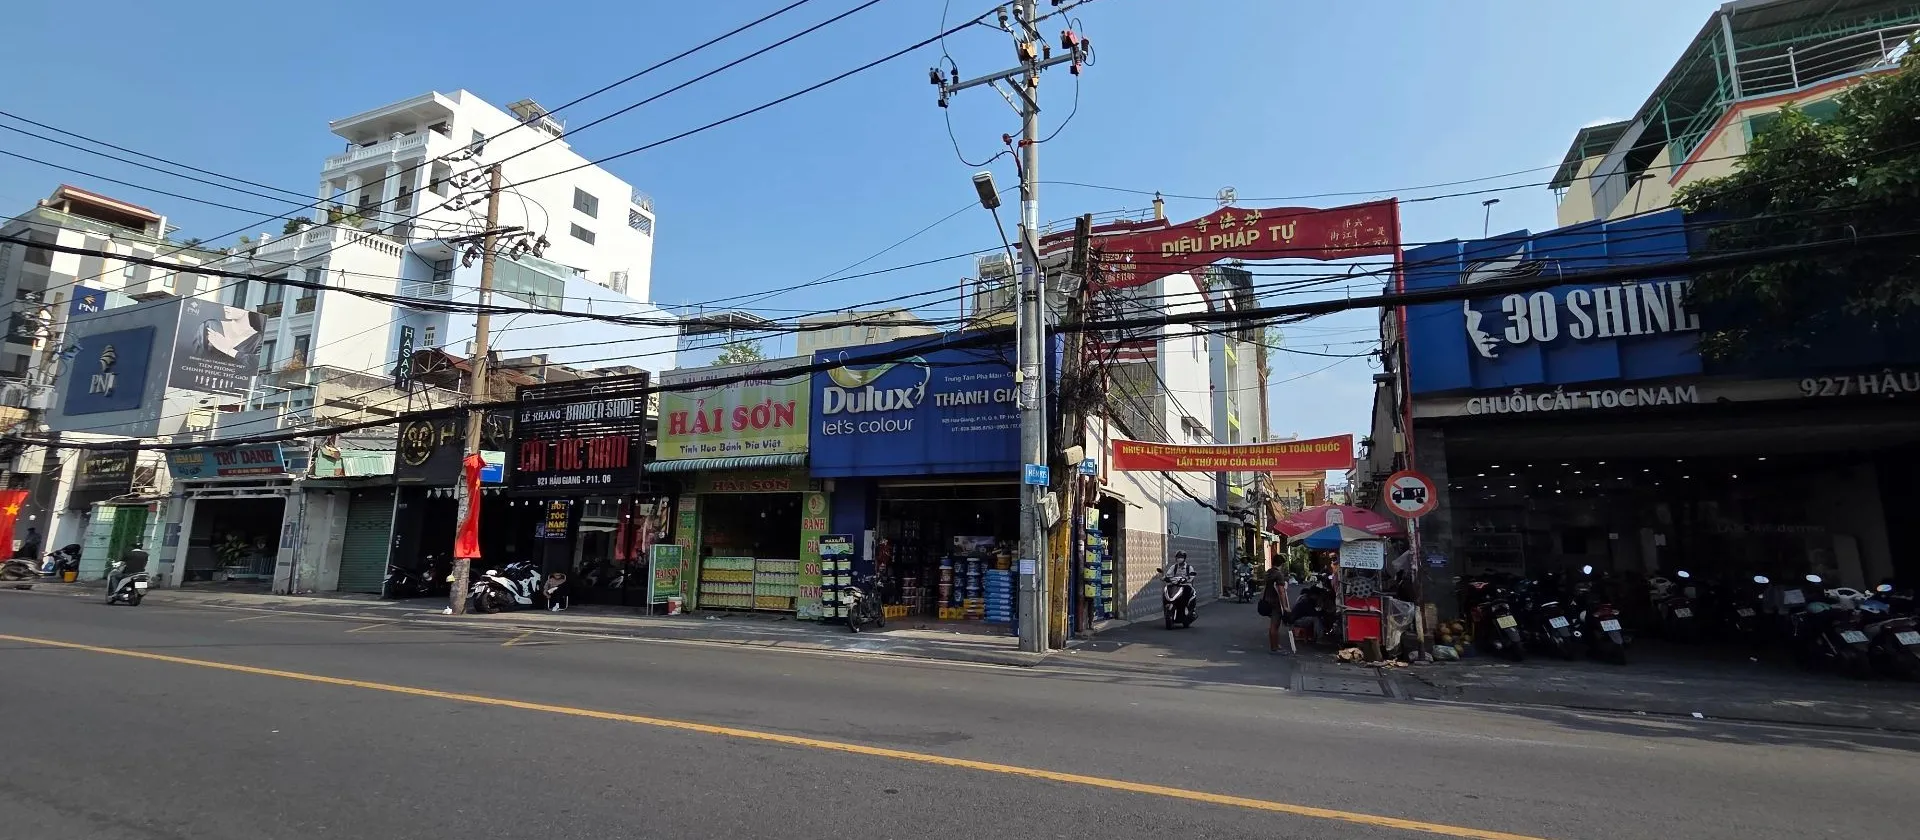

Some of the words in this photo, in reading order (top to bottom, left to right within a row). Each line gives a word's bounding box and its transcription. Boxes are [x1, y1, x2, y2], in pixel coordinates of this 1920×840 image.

[1210, 227, 1260, 250] PHÁP
[1268, 220, 1296, 244] TỰ
[78, 302, 98, 312] PNJ
[1502, 291, 1558, 344] 30
[1566, 280, 1700, 340] SHINE
[88, 372, 116, 397] PNJ
[1800, 376, 1850, 396] 927
[1858, 368, 1920, 398] HẬU
[823, 386, 914, 414] Dulux
[934, 390, 989, 406] THÀNH
[1466, 388, 1532, 416] CHUỖI
[1536, 385, 1580, 410] CẮT
[532, 410, 561, 421] KHANG
[605, 400, 634, 418] SHOP
[669, 399, 724, 435] HẢI
[732, 397, 796, 431] SƠN
[822, 420, 854, 436] let's
[858, 417, 914, 433] colour
[700, 444, 717, 453] Hoa
[762, 440, 781, 451] Việt
[1230, 456, 1248, 466] CỦA
[602, 474, 611, 483] Q6
[804, 515, 825, 530] BÁNH
[805, 560, 820, 575] SÓC
